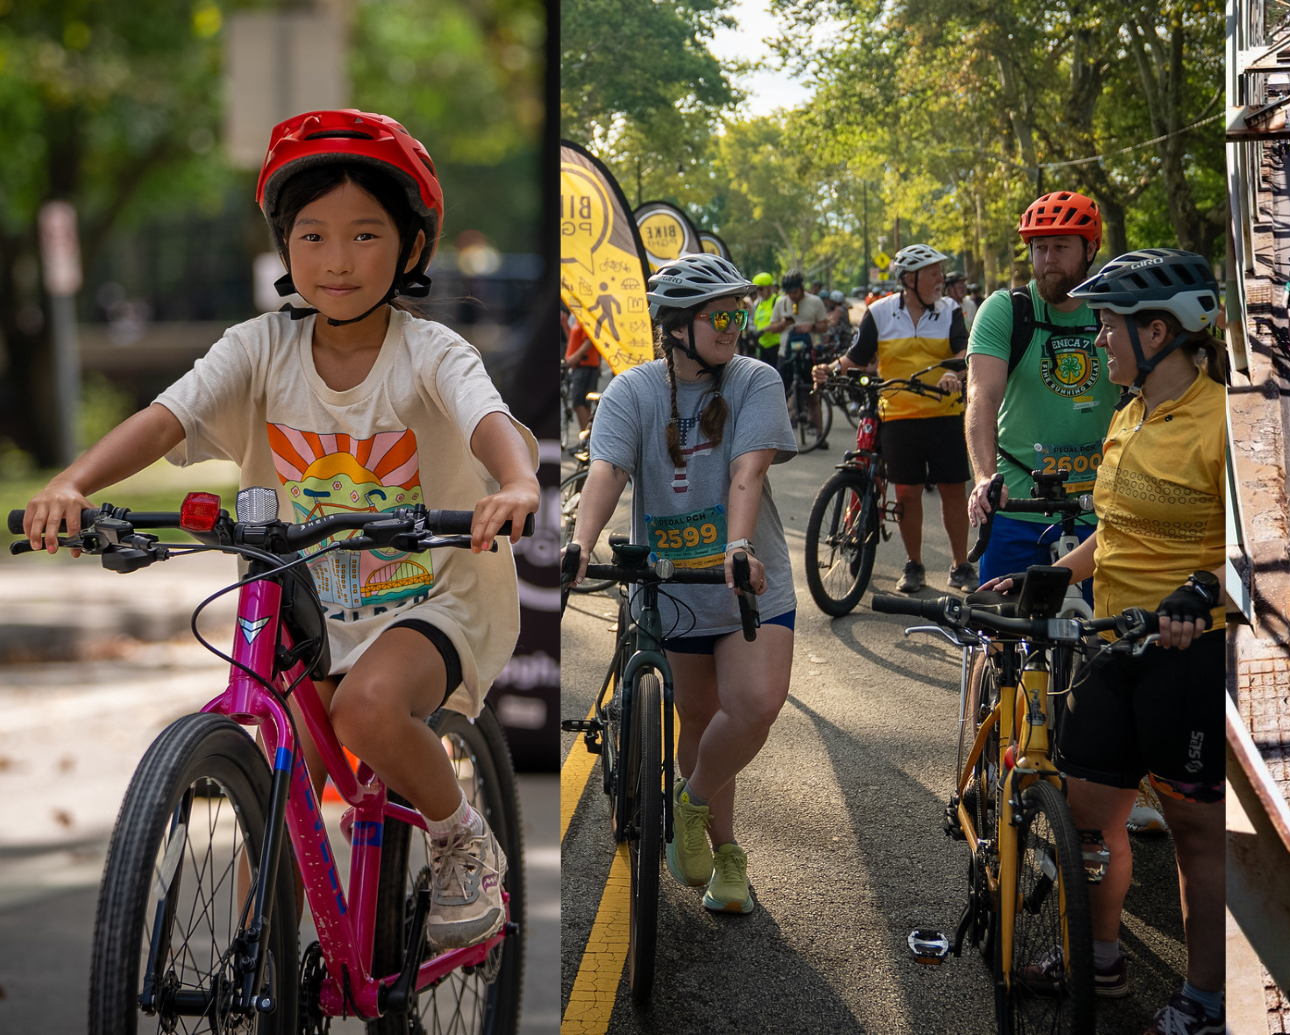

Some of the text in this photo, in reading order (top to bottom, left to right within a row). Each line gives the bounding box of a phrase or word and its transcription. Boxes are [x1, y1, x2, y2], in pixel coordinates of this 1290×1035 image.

[1130, 257, 1164, 270] GIRO
[662, 276, 683, 284] GIRO
[1051, 338, 1090, 350] ENECA 7
[1050, 382, 1086, 396] RUNNING
[1087, 361, 1099, 386] RELAY
[1042, 453, 1102, 475] 2600
[659, 513, 706, 526] PEDAL PGH
[654, 523, 718, 549] 2599
